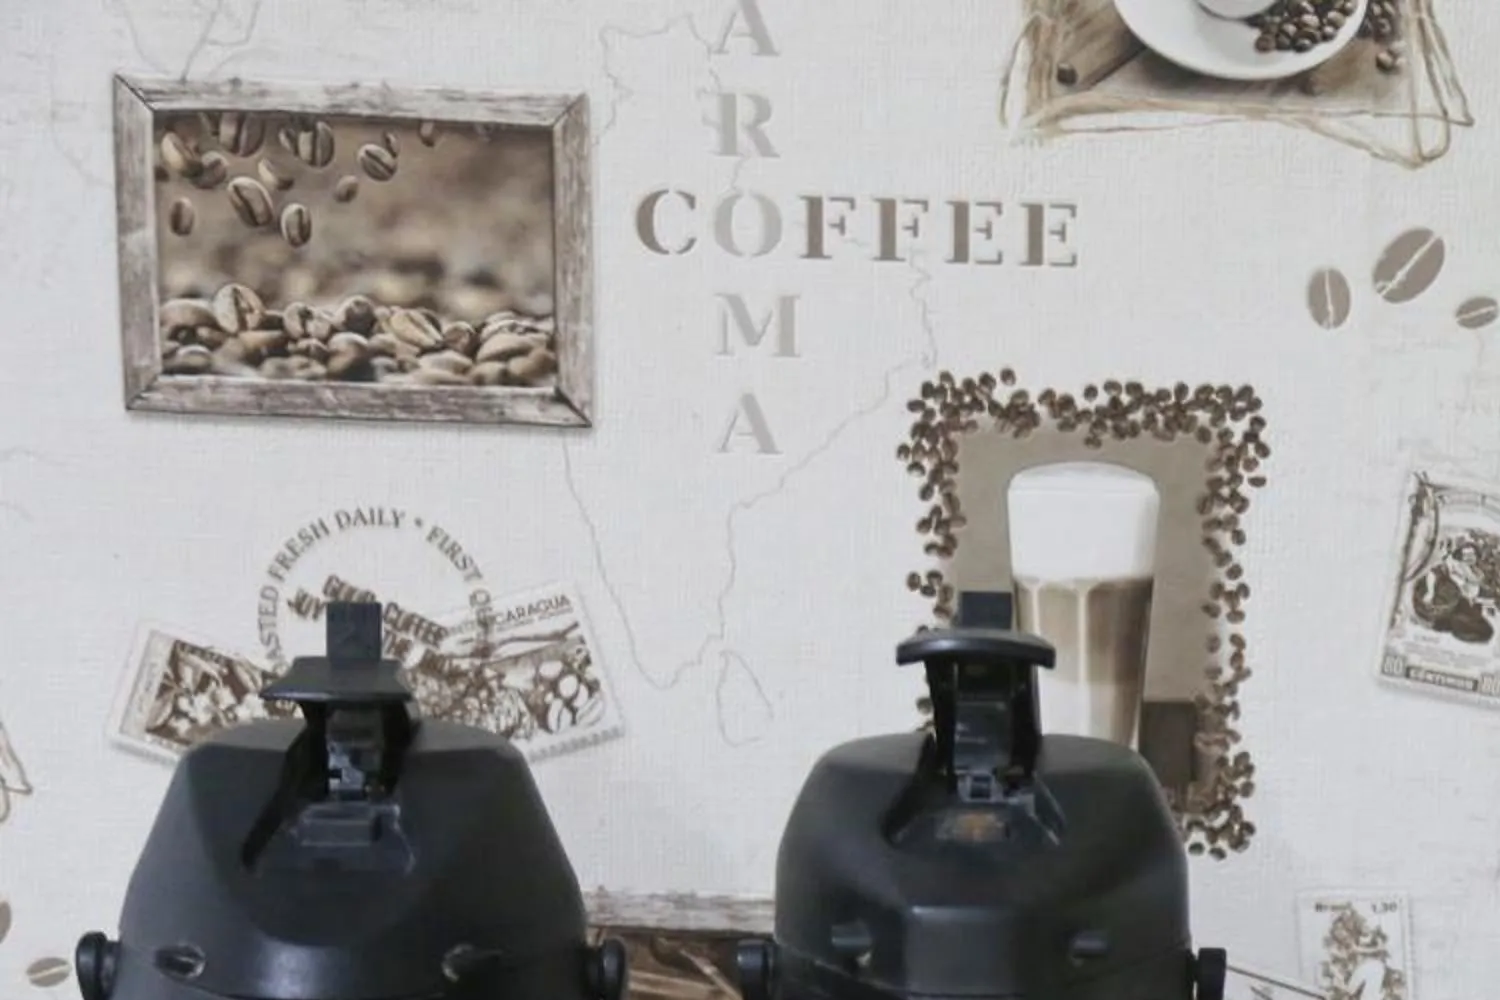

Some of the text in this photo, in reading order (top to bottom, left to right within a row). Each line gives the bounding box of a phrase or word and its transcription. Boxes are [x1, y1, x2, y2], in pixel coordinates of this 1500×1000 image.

[635, 189, 1077, 267] COFFEE
[268, 517, 330, 583] FRESH
[335, 506, 405, 531] DAILY
[425, 526, 483, 583] FIRST
